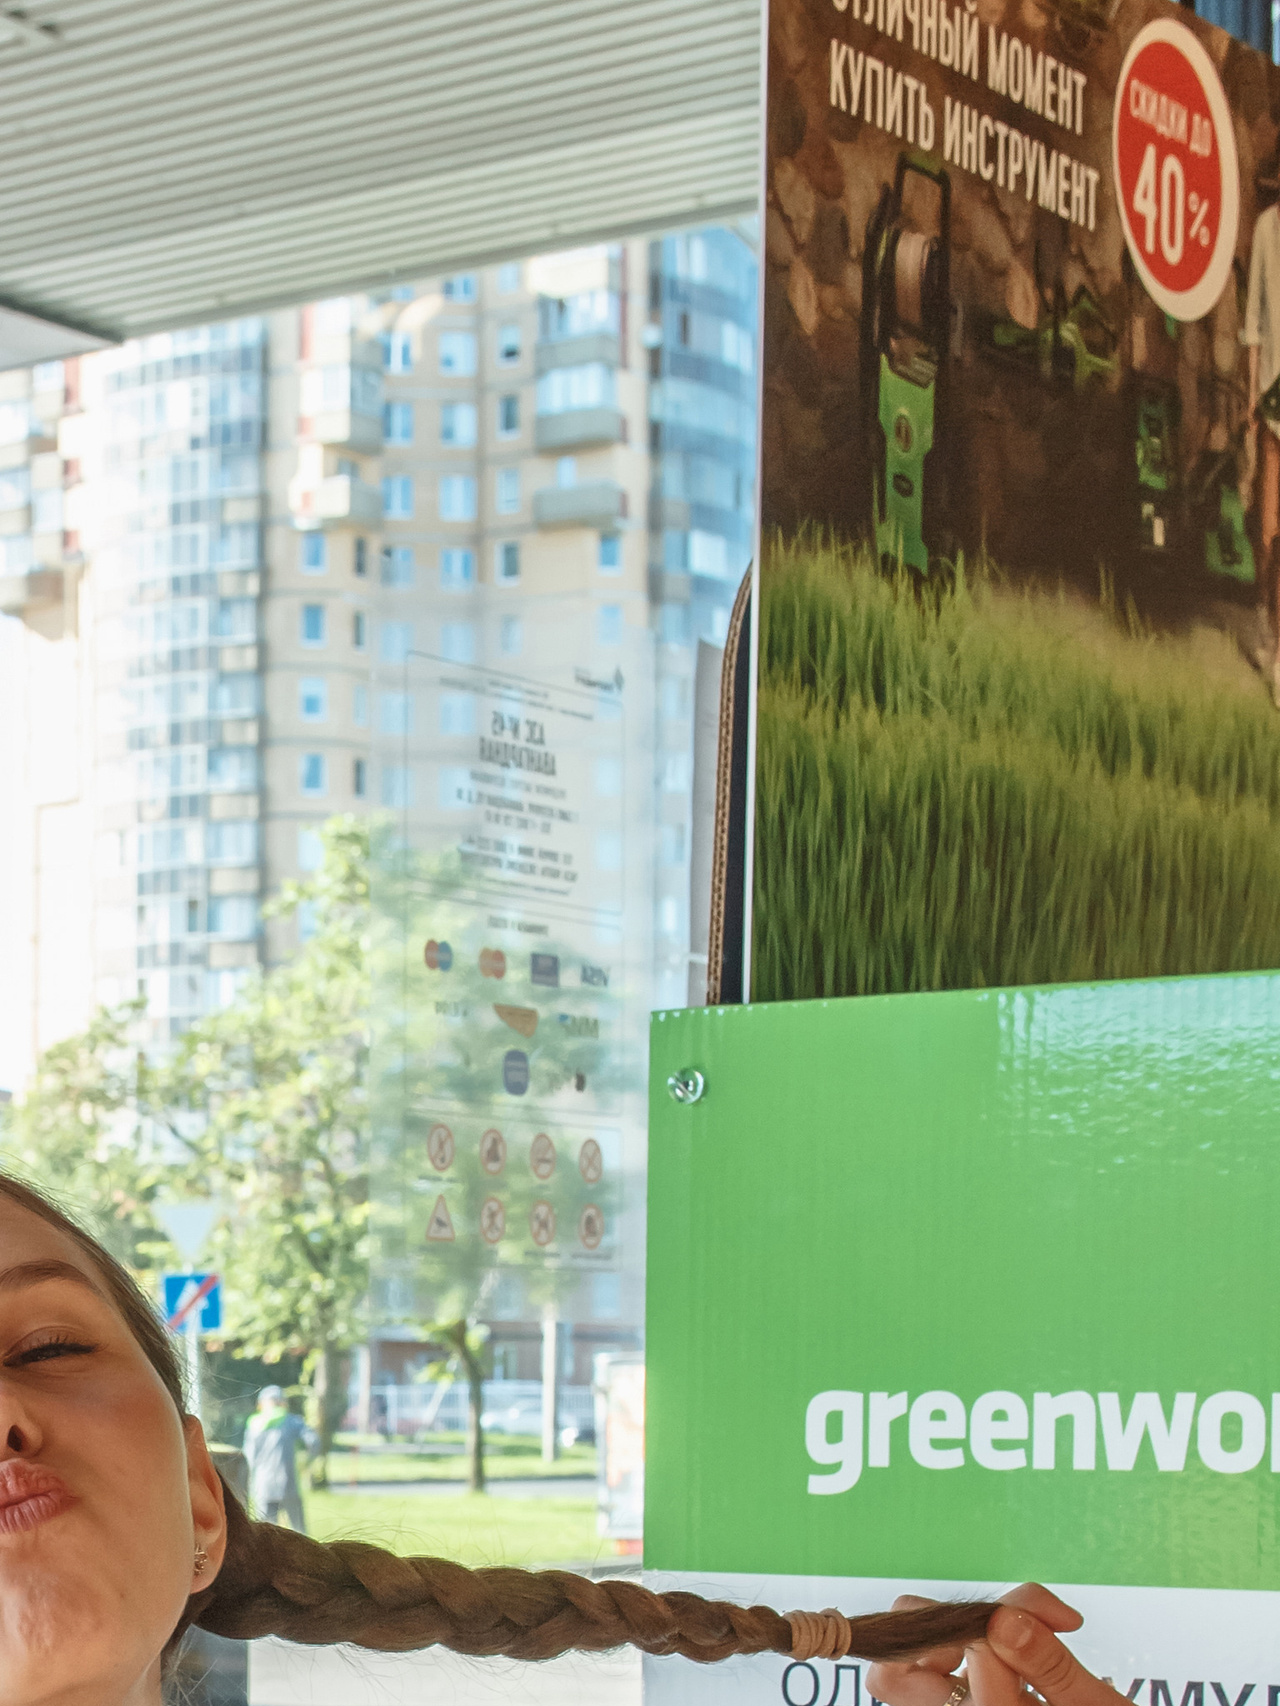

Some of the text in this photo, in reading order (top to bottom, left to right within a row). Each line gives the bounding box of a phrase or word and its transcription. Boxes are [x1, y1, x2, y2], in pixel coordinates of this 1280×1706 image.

[830, 38, 1100, 232] КУПИТЬ ИНСТРУМЕНТ
[988, 25, 1087, 136] МОМЕНТ
[1130, 78, 1212, 158] СКИДКИ ДО
[1133, 142, 1212, 266] 40%
[804, 1389, 1280, 1496] greenwo
